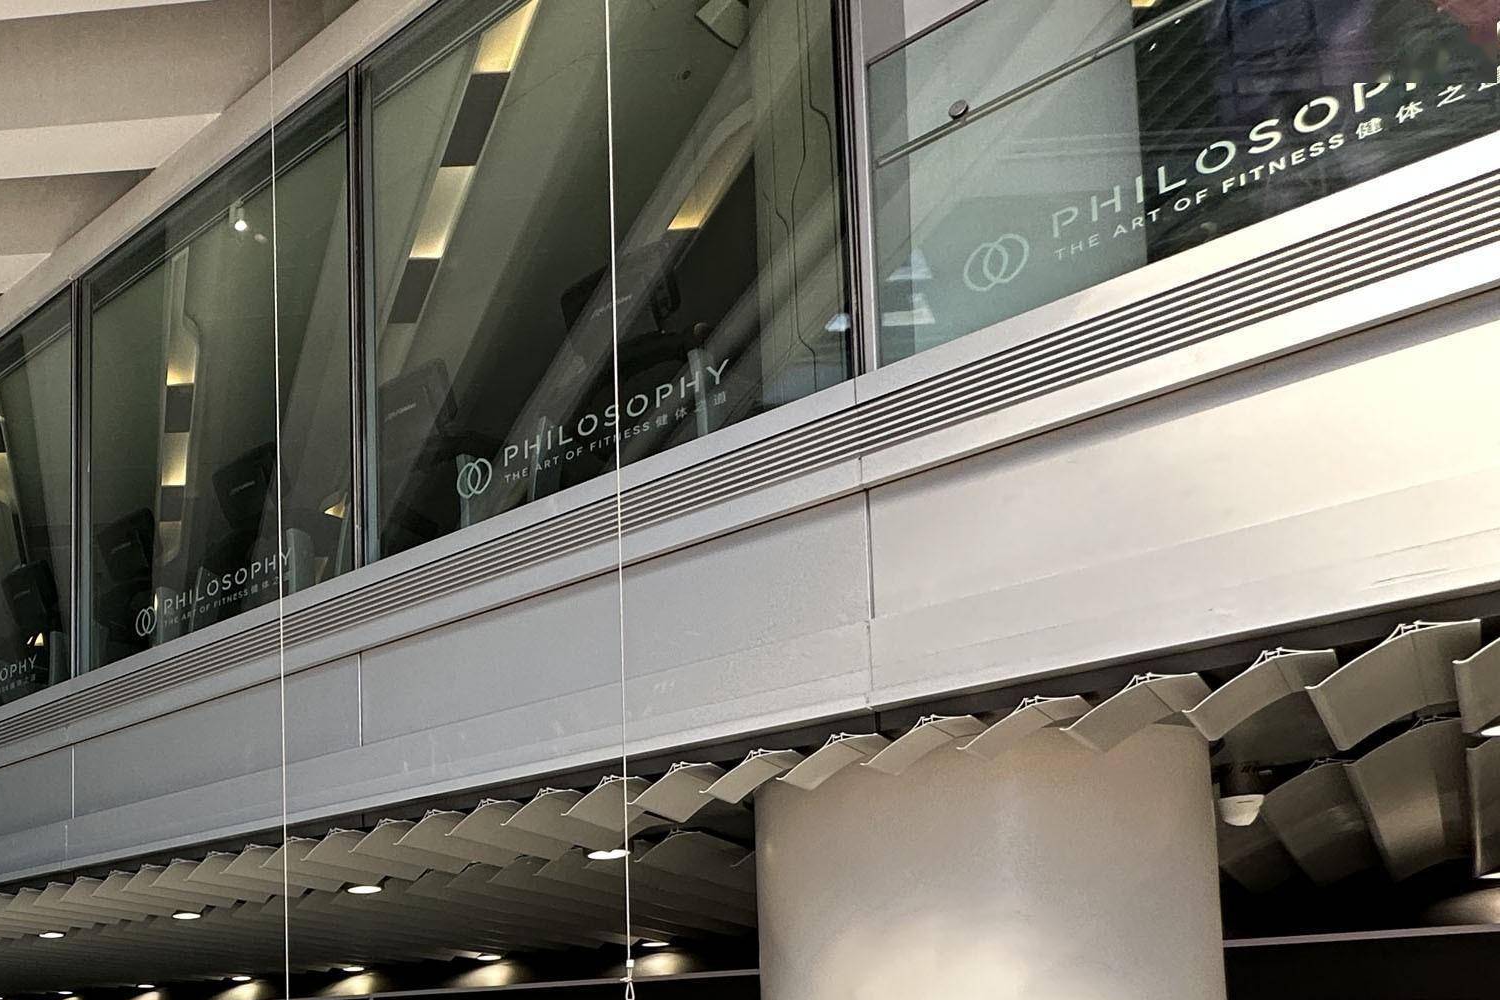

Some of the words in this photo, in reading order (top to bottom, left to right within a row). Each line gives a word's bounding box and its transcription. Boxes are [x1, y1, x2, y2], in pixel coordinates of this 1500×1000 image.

[1052, 73, 1417, 238] PHILOSOP
[1054, 234, 1100, 261] THE
[1113, 208, 1160, 237] ART
[1173, 188, 1208, 212] OF
[1221, 133, 1345, 194] FITNESS
[1356, 80, 1500, 139] 健体之
[504, 359, 730, 467] PHILOSOPHY
[505, 467, 529, 483] THE
[534, 456, 560, 473] ART
[565, 446, 583, 461] OF
[590, 422, 650, 452] FITNESS
[164, 548, 292, 614] PHILOSOPHY
